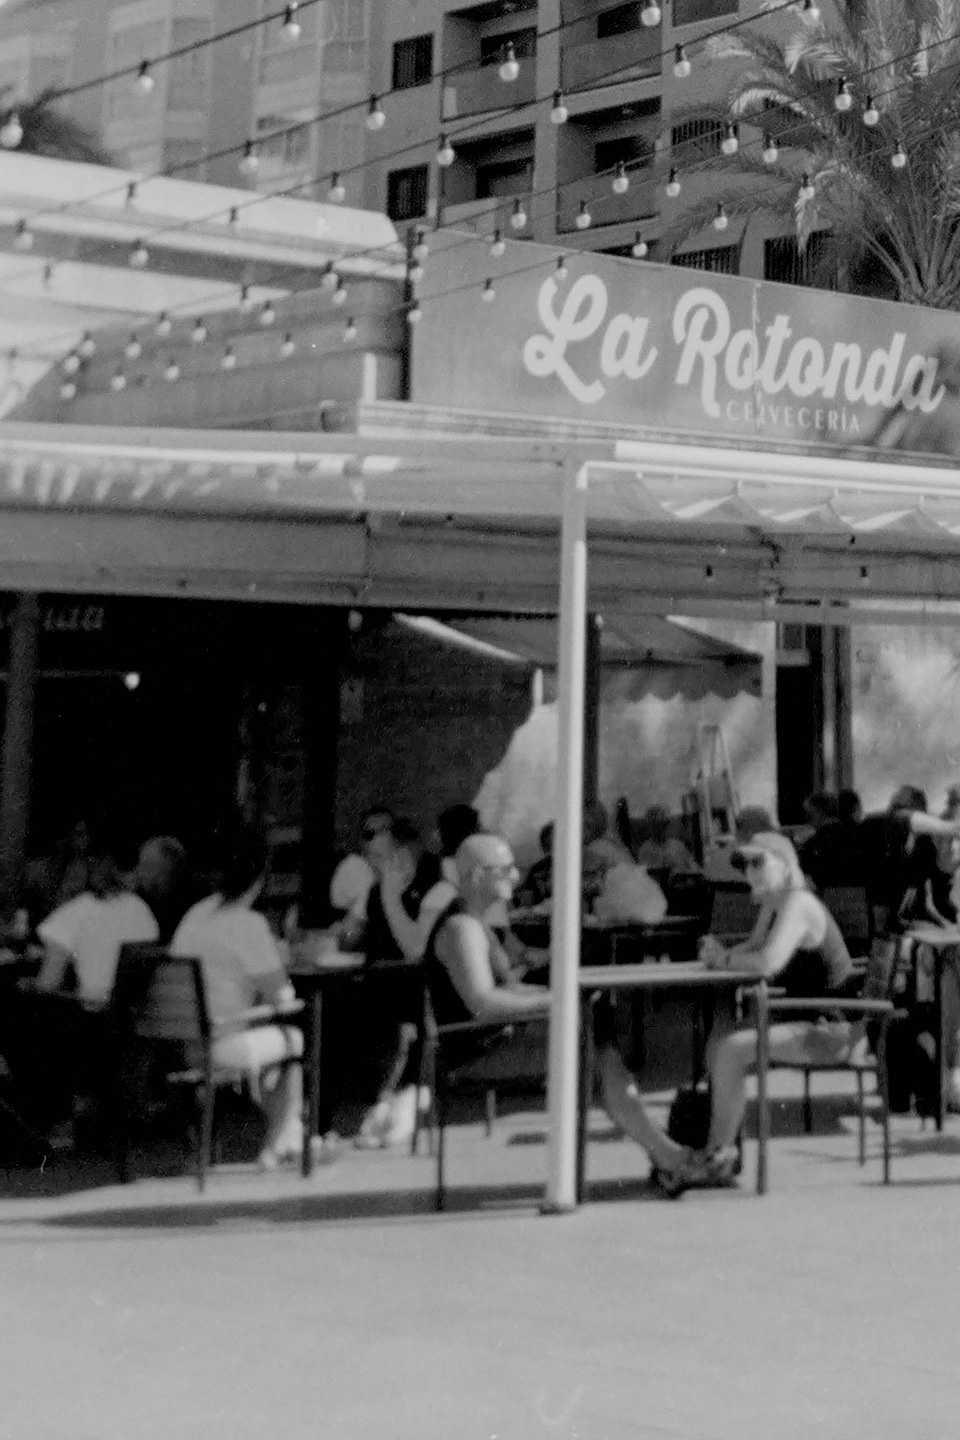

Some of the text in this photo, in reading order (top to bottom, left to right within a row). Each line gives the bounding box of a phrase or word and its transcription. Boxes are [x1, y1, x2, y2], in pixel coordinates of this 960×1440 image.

[523, 274, 946, 417] La Rotonda
[726, 399, 860, 433] CERVECERÍA
